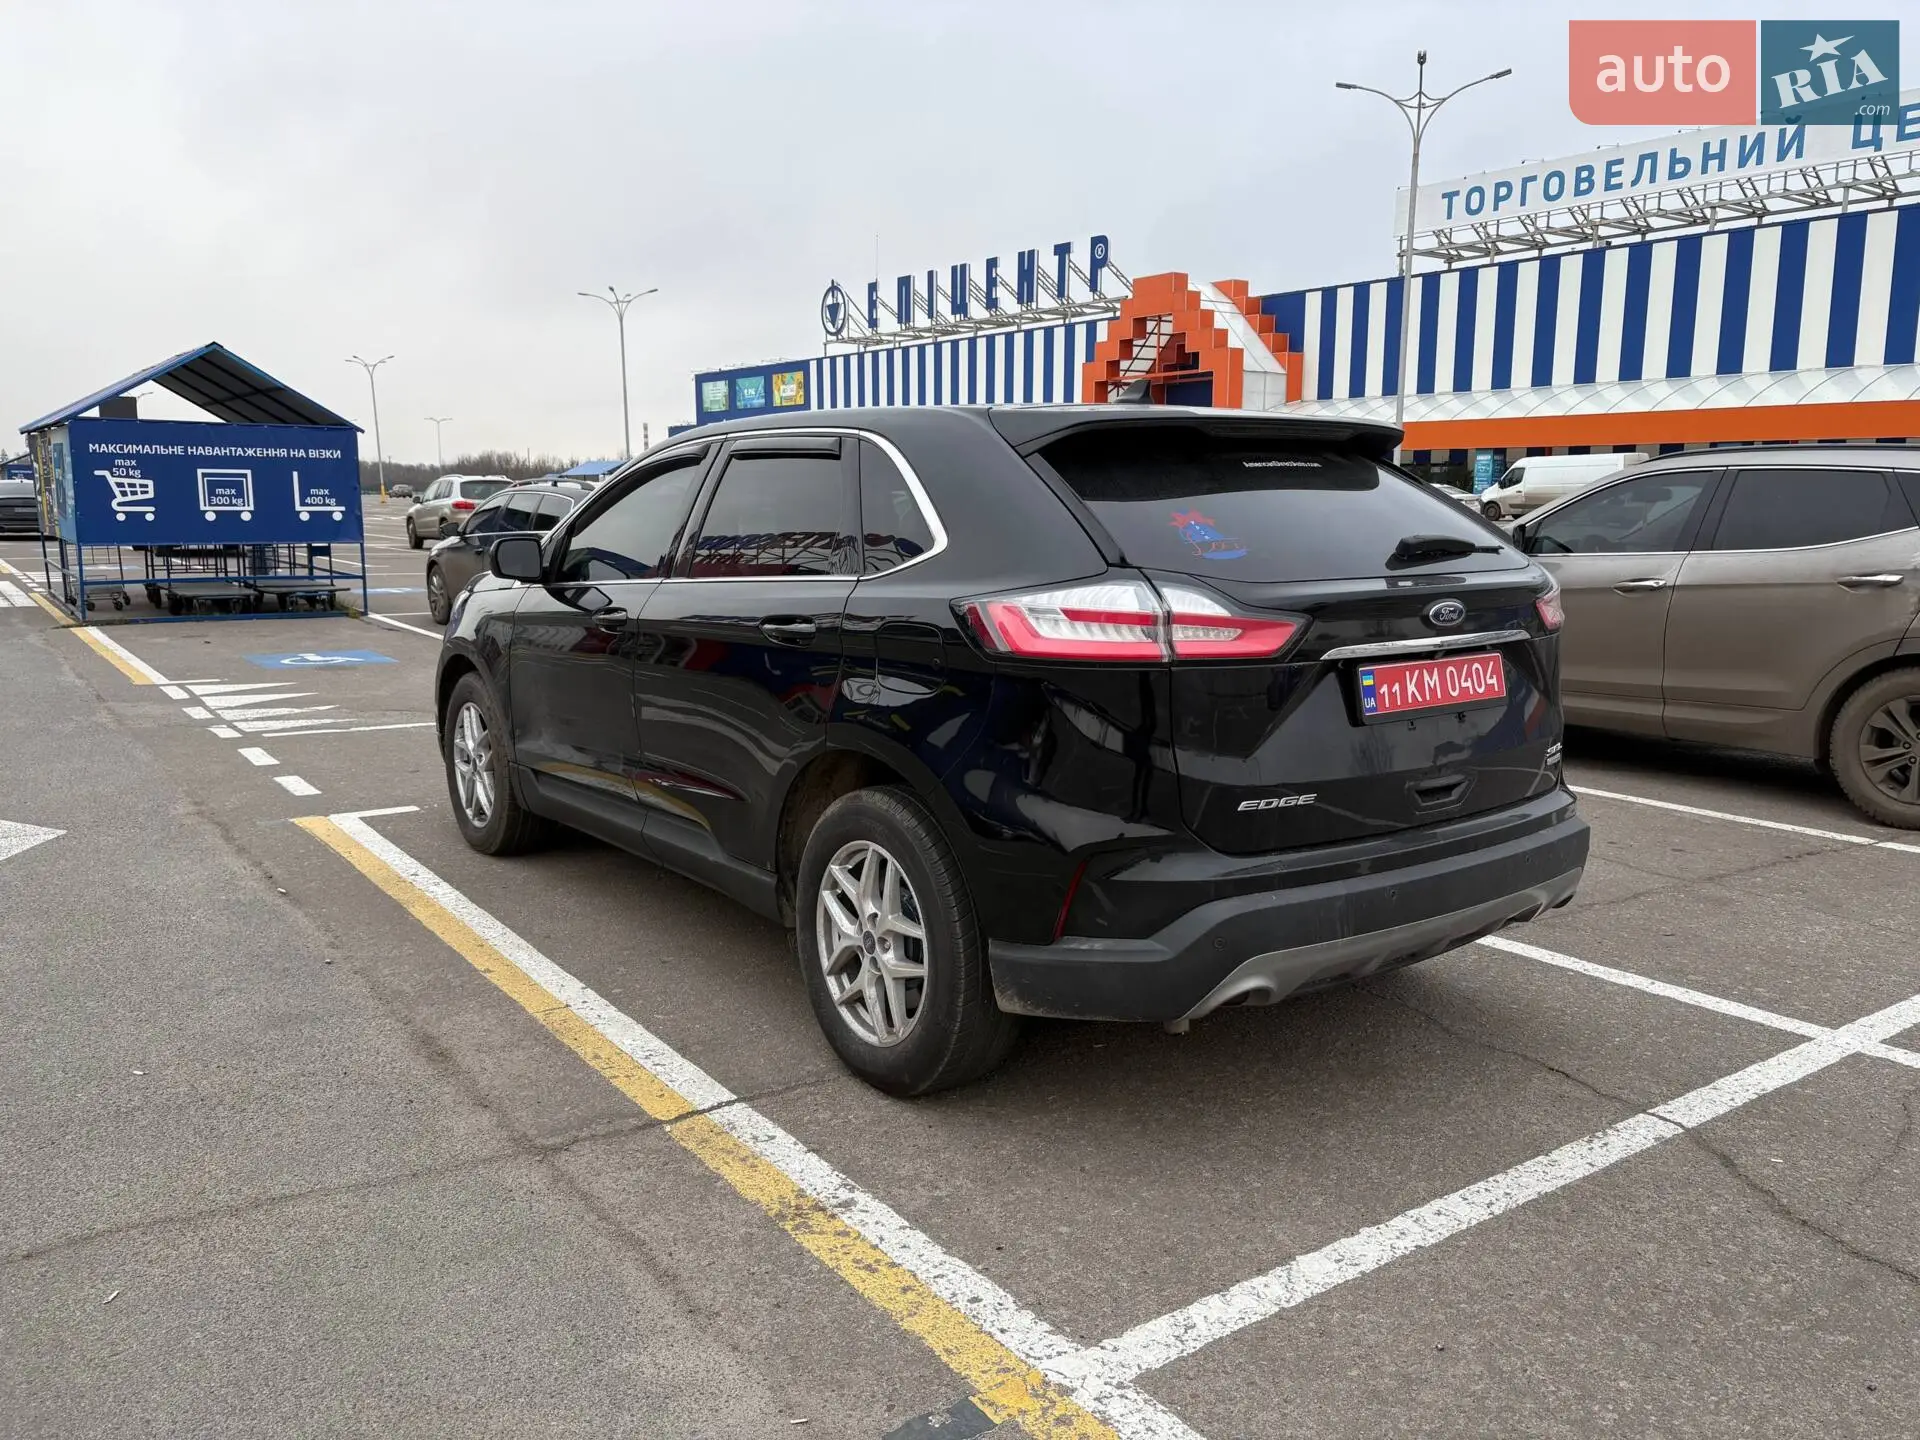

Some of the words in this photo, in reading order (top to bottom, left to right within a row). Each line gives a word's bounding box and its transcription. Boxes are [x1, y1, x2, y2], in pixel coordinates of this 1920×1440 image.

[1441, 114, 1807, 221] ТОРГОВЕЛЬНИЙ
[867, 234, 1110, 329] ЕПІЦЕНТР
[88, 443, 185, 456] МАКСИМАЛЬНЕ
[187, 446, 288, 458] НАВАНТАЖЕННЯ
[290, 448, 306, 459] НА
[308, 449, 342, 459] ВІЗКИ
[114, 459, 137, 467] max
[112, 467, 127, 477] 50
[128, 467, 142, 478] kg
[215, 488, 237, 496] max
[310, 488, 330, 496] max
[210, 496, 233, 505] 300
[234, 496, 244, 507] kg
[304, 496, 326, 505] 400
[326, 496, 336, 507] kg
[1379, 682, 1401, 708] 11
[1405, 667, 1442, 703] KM
[1446, 660, 1499, 698] 0404
[1364, 697, 1377, 709] UA
[1237, 793, 1318, 812] EDGE
